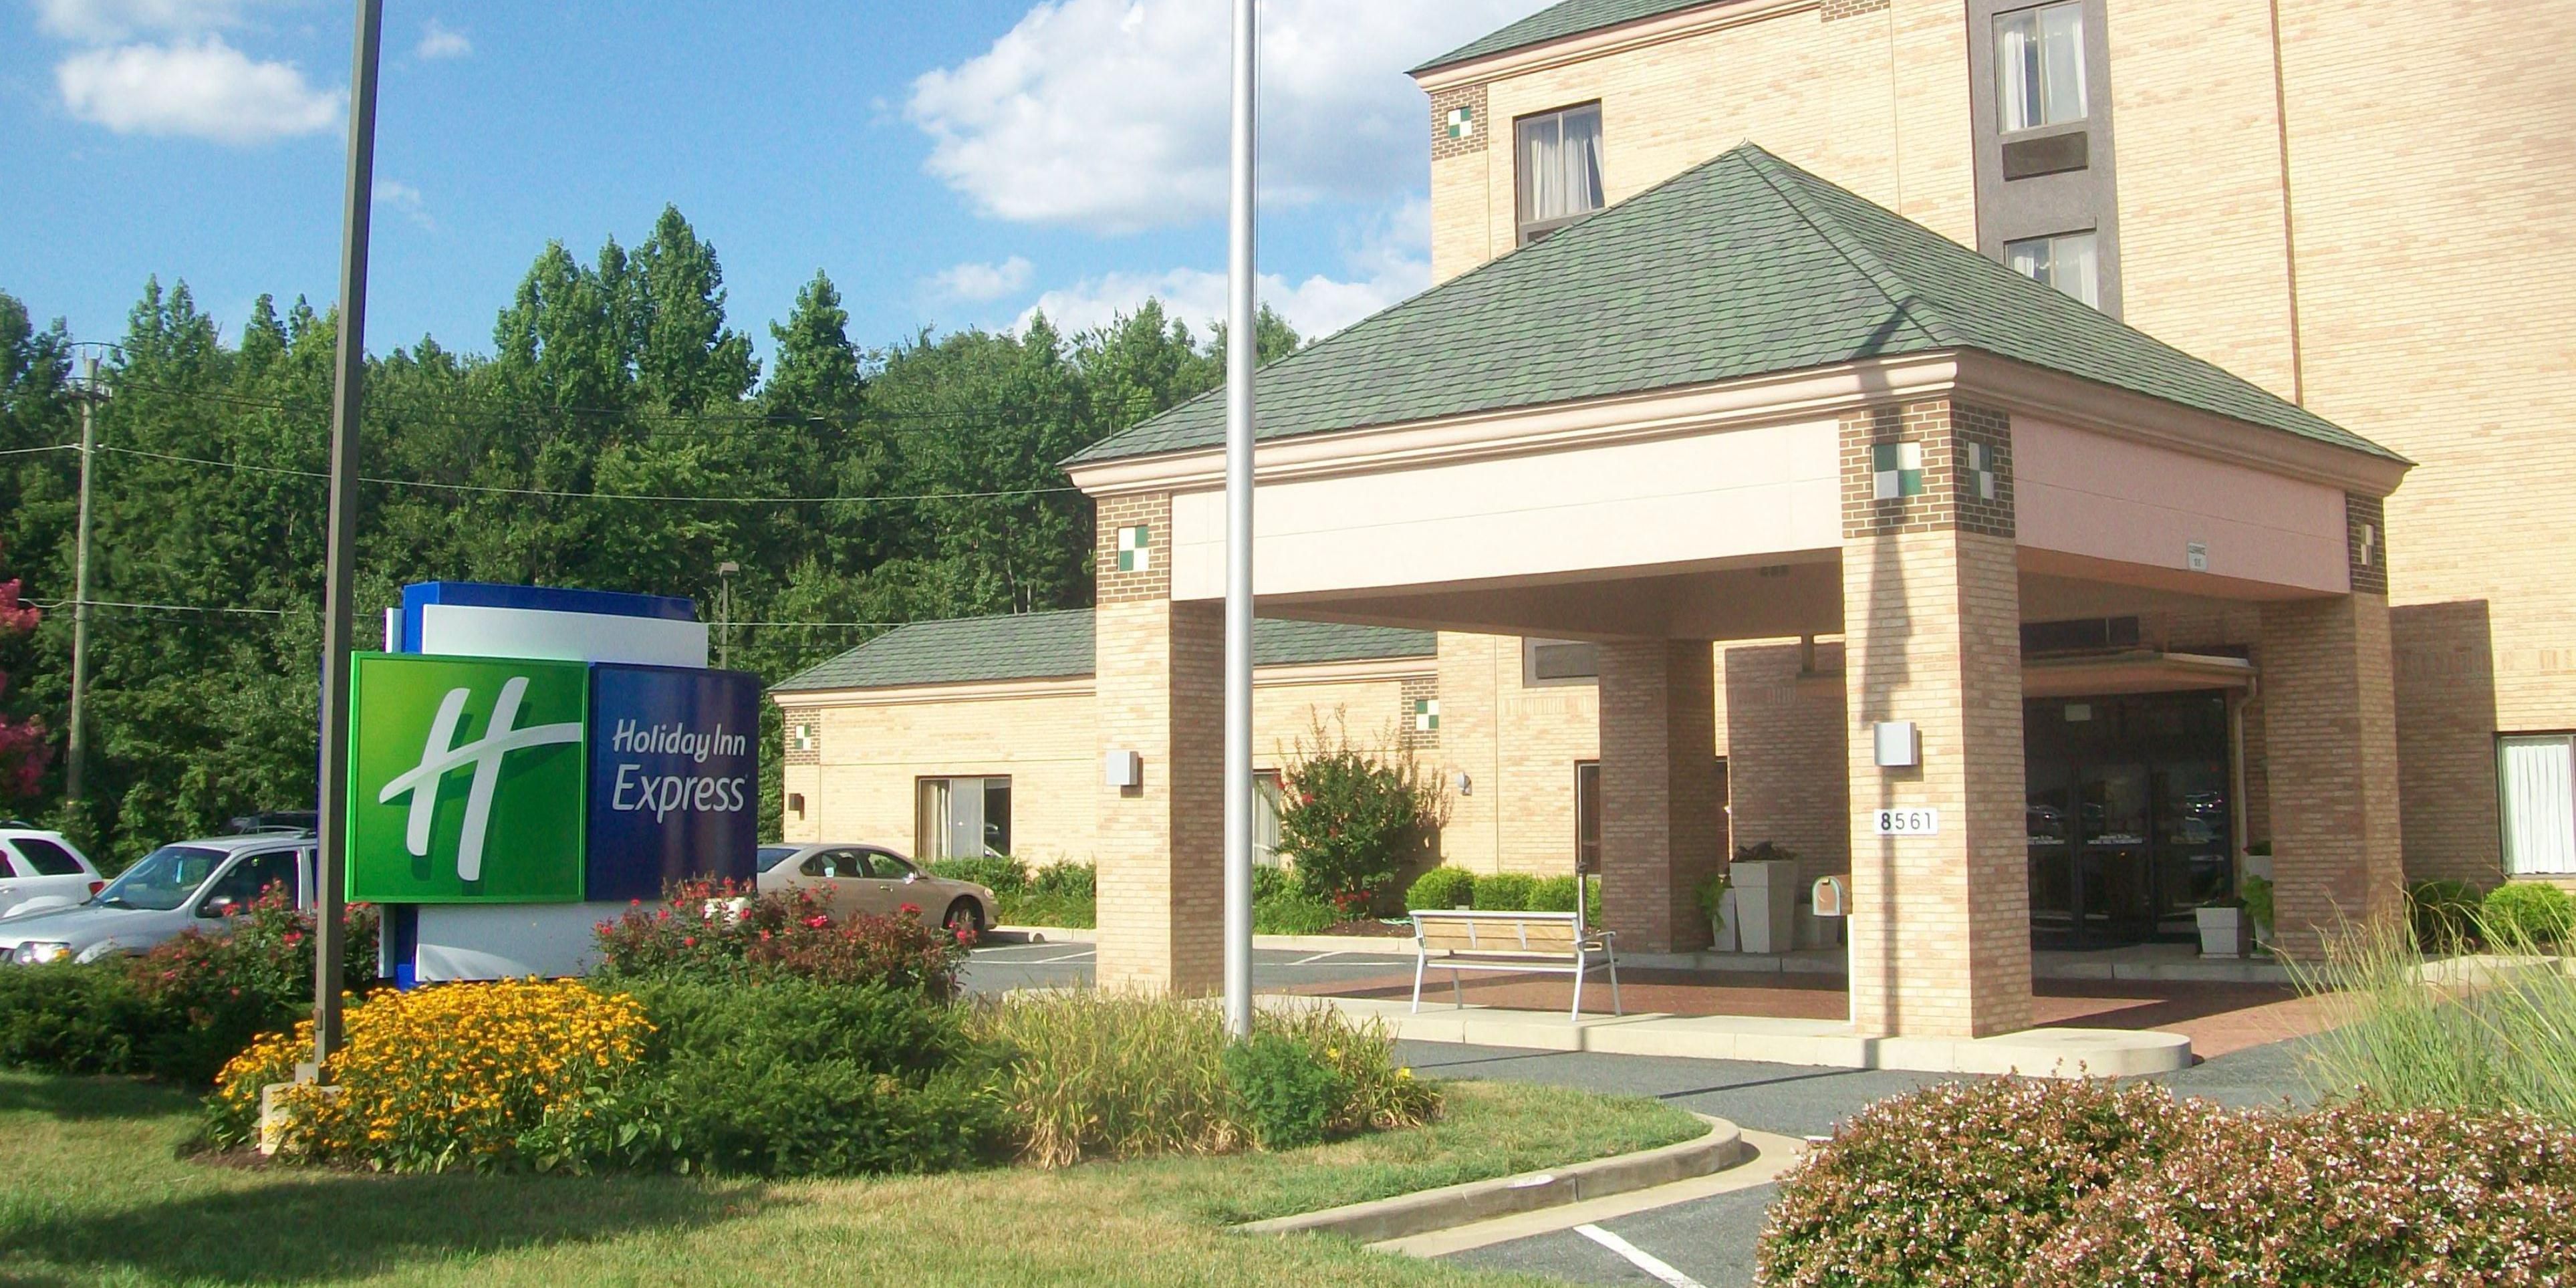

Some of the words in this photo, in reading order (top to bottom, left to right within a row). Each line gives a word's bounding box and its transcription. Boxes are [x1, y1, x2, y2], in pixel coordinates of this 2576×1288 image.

[612, 719, 711, 763] Holiday
[713, 723, 745, 756] Inn
[612, 764, 745, 824] Express
[1881, 812, 1930, 830] 8561
